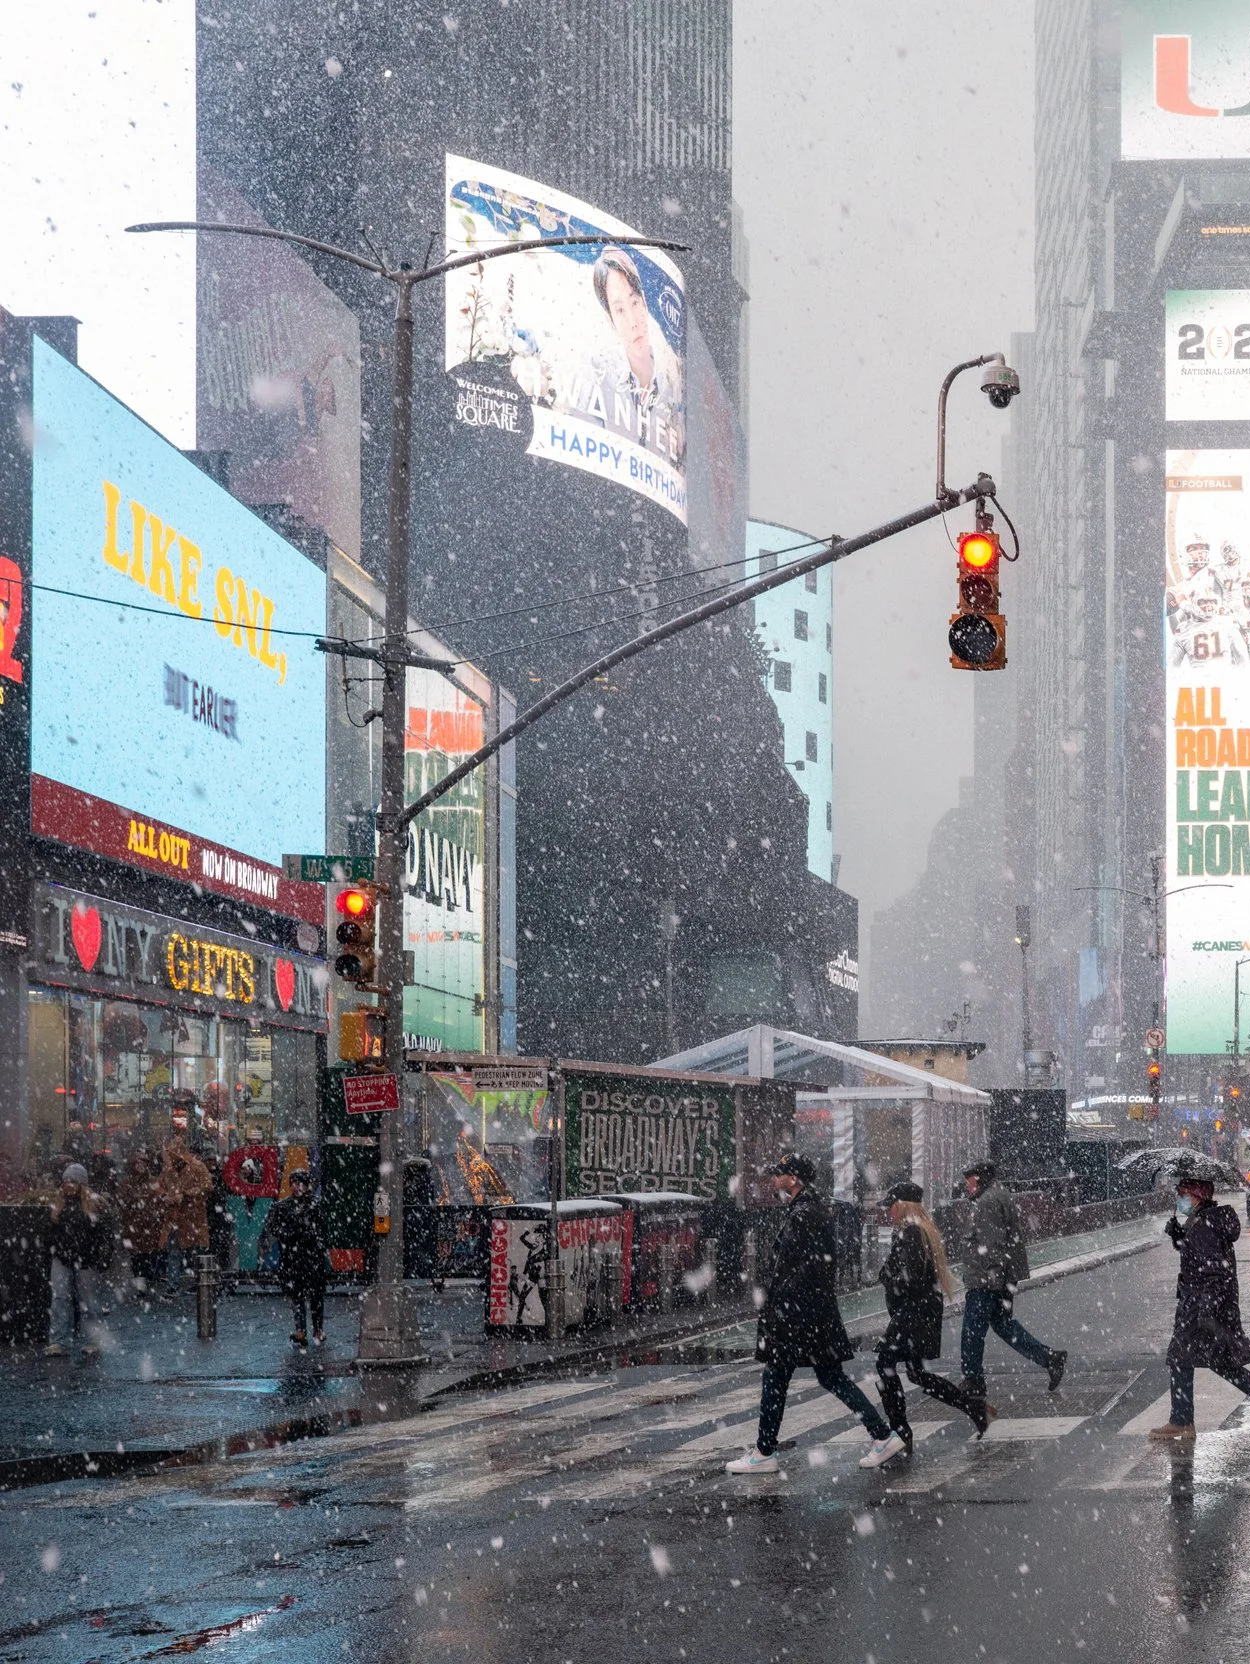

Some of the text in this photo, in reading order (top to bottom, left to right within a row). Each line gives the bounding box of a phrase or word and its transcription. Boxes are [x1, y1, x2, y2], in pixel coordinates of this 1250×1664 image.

[1181, 367, 1222, 377] NATIONAL
[456, 378, 519, 401] WELCOME TO
[456, 403, 520, 434] SQUARE
[482, 397, 518, 417] TIMES
[550, 426, 687, 511] HAPPY BIRTHDAY
[1182, 479, 1233, 489] FOOTBALL
[102, 479, 203, 621] LIKE
[213, 566, 288, 686] SNL,
[1193, 632, 1225, 661] 61
[1174, 687, 1227, 727] ALL
[127, 819, 190, 869] ALL OUT
[202, 849, 279, 900] NOW ON BROADWAY
[424, 827, 479, 912] NAVY
[52, 898, 156, 984] I NY
[167, 932, 255, 1004] GIFTS
[358, 1077, 391, 1087] STOPPING
[474, 1071, 544, 1080] PEDESTRIAN FLOW ZONE
[521, 1080, 545, 1089] MOVING
[581, 1091, 719, 1118] DISCOVER
[578, 1112, 720, 1177] BROADWAY'S
[578, 1171, 718, 1202] SECRETS
[557, 1214, 622, 1250] CHICAGO
[490, 1218, 509, 1326] CHICAGO
